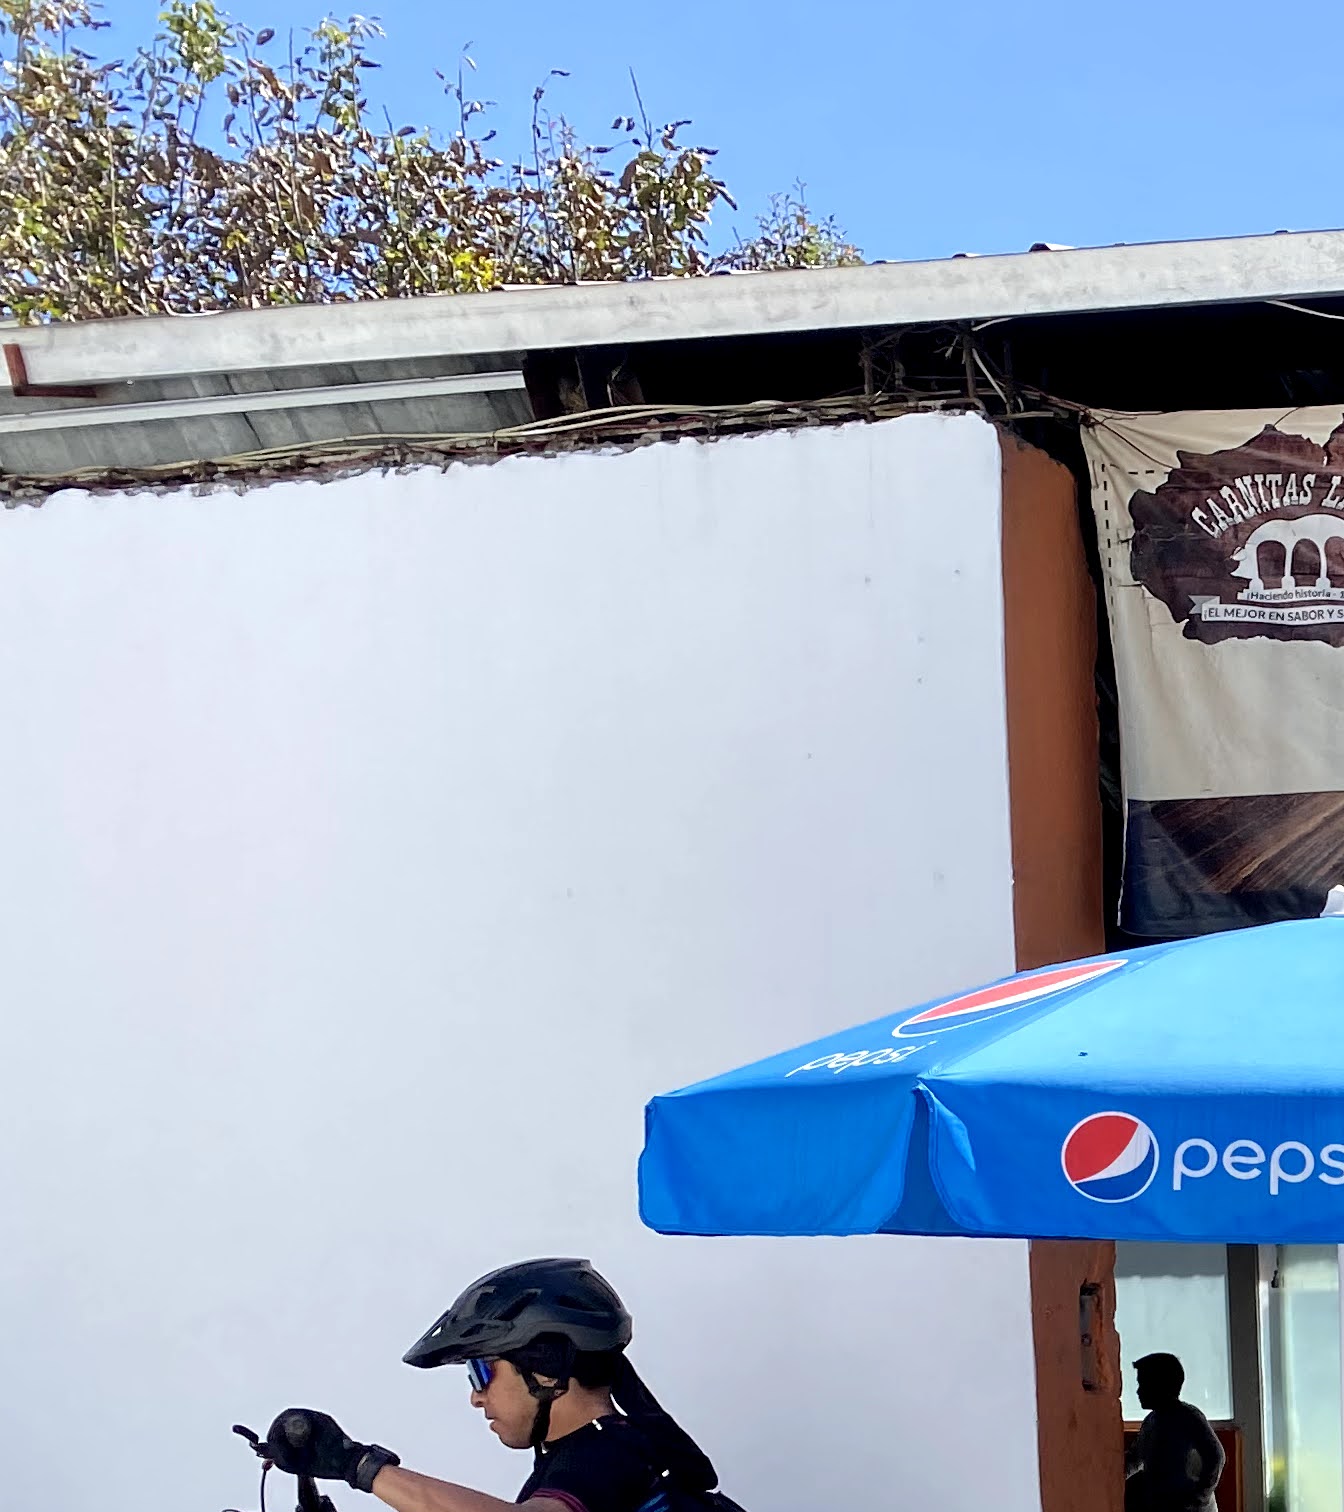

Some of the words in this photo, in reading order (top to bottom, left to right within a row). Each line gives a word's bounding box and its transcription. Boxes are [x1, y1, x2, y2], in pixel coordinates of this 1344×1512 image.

[1191, 473, 1316, 539] CARNITAS
[1295, 588, 1331, 600] historia
[1224, 608, 1266, 620] MEJOR
[1269, 611, 1285, 621] EN
[1287, 609, 1325, 622] SABOR
[1327, 608, 1335, 619] Y
[785, 1041, 938, 1078] pepsi
